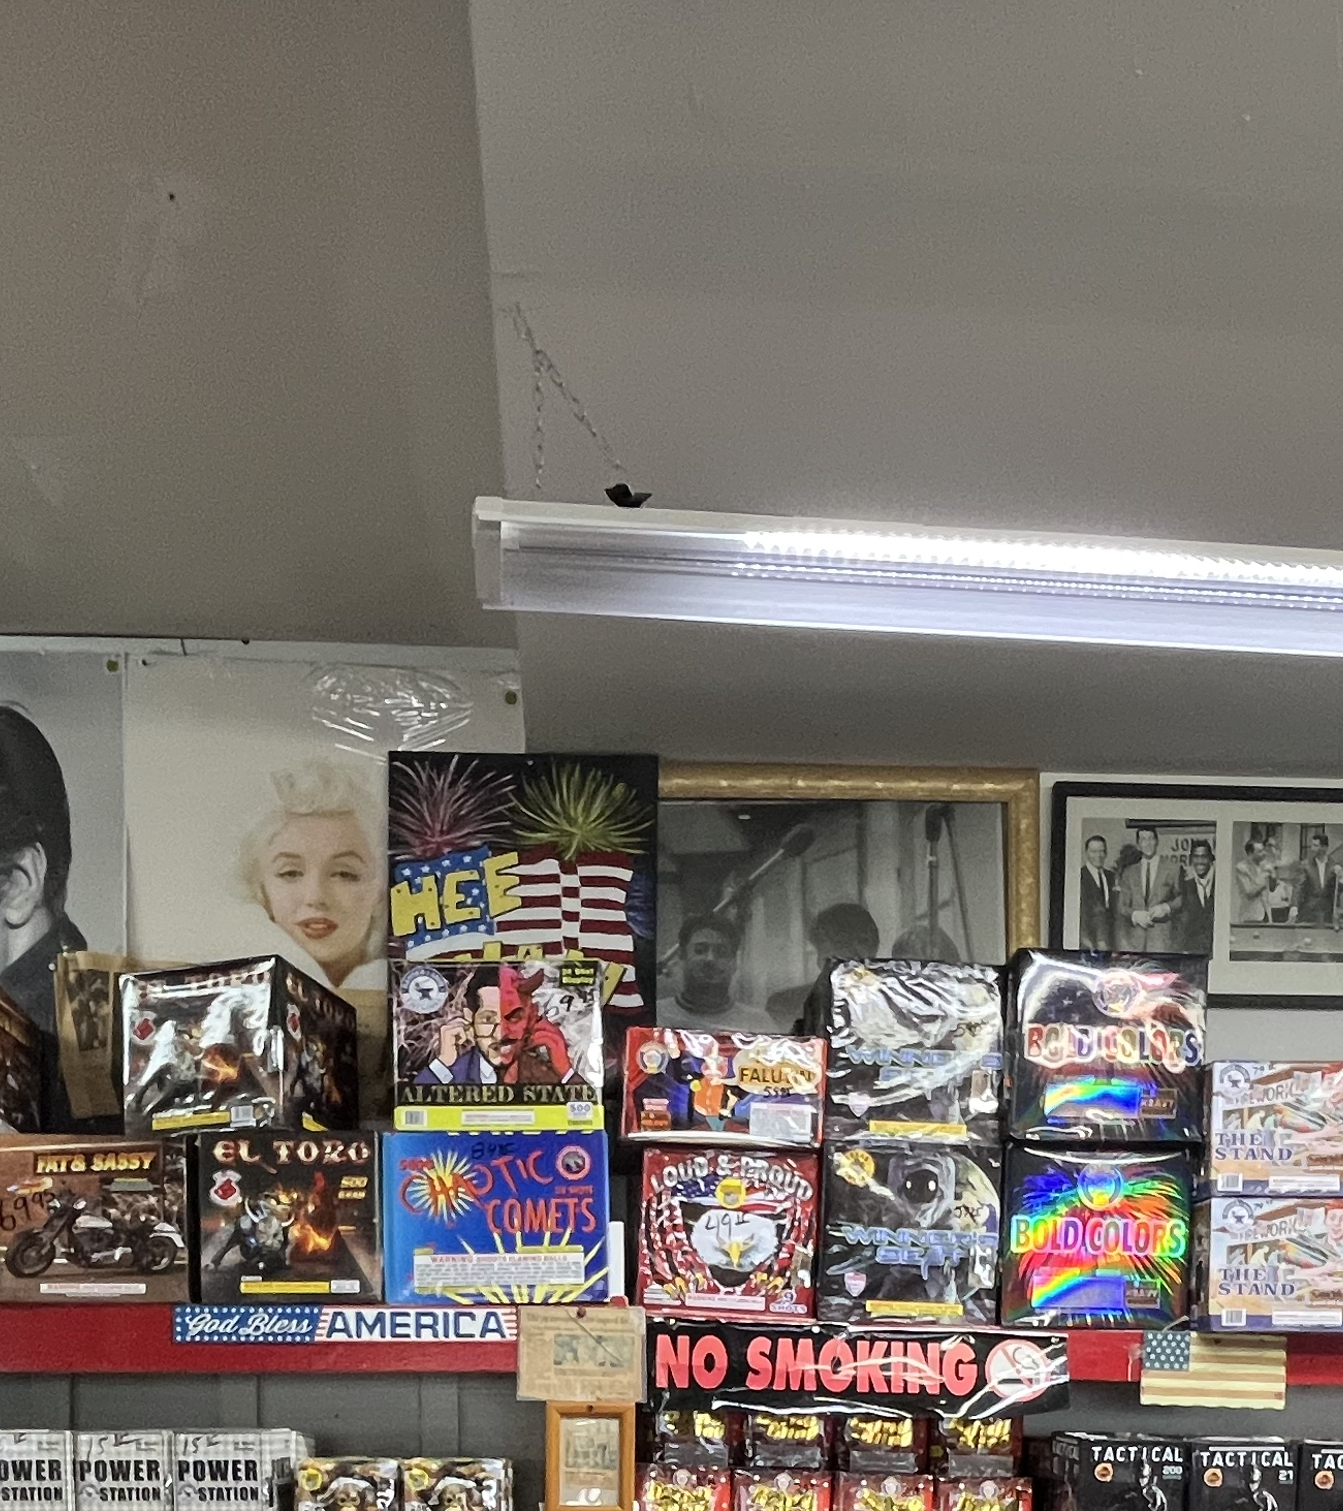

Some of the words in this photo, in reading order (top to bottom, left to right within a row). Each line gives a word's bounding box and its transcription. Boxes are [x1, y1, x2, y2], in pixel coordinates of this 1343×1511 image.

[390, 852, 522, 937] HEE
[401, 1082, 514, 1103] ALTERED
[523, 1082, 598, 1102] STATE
[211, 1139, 263, 1163] EL
[273, 1139, 371, 1163] TORO
[651, 1158, 710, 1194] LOUD
[716, 1154, 737, 1177] &
[740, 1156, 814, 1201] PROUD
[490, 1198, 598, 1234] COMETS
[1012, 1216, 1084, 1253] BOLD
[1085, 1217, 1187, 1257] COLORS
[1219, 1268, 1267, 1281] THE
[1219, 1283, 1296, 1296] STAND
[188, 1312, 238, 1337] God
[238, 1312, 312, 1337] Bless
[326, 1312, 506, 1339] AMERICA
[657, 1335, 728, 1390] NO
[747, 1336, 978, 1394] SMOKING
[1092, 1445, 1183, 1463] TACTICAL
[1200, 1449, 1293, 1468] TACTICAL
[178, 1459, 257, 1482] POWER
[1278, 1470, 1293, 1480] 21
[198, 1486, 258, 1501] STATION
